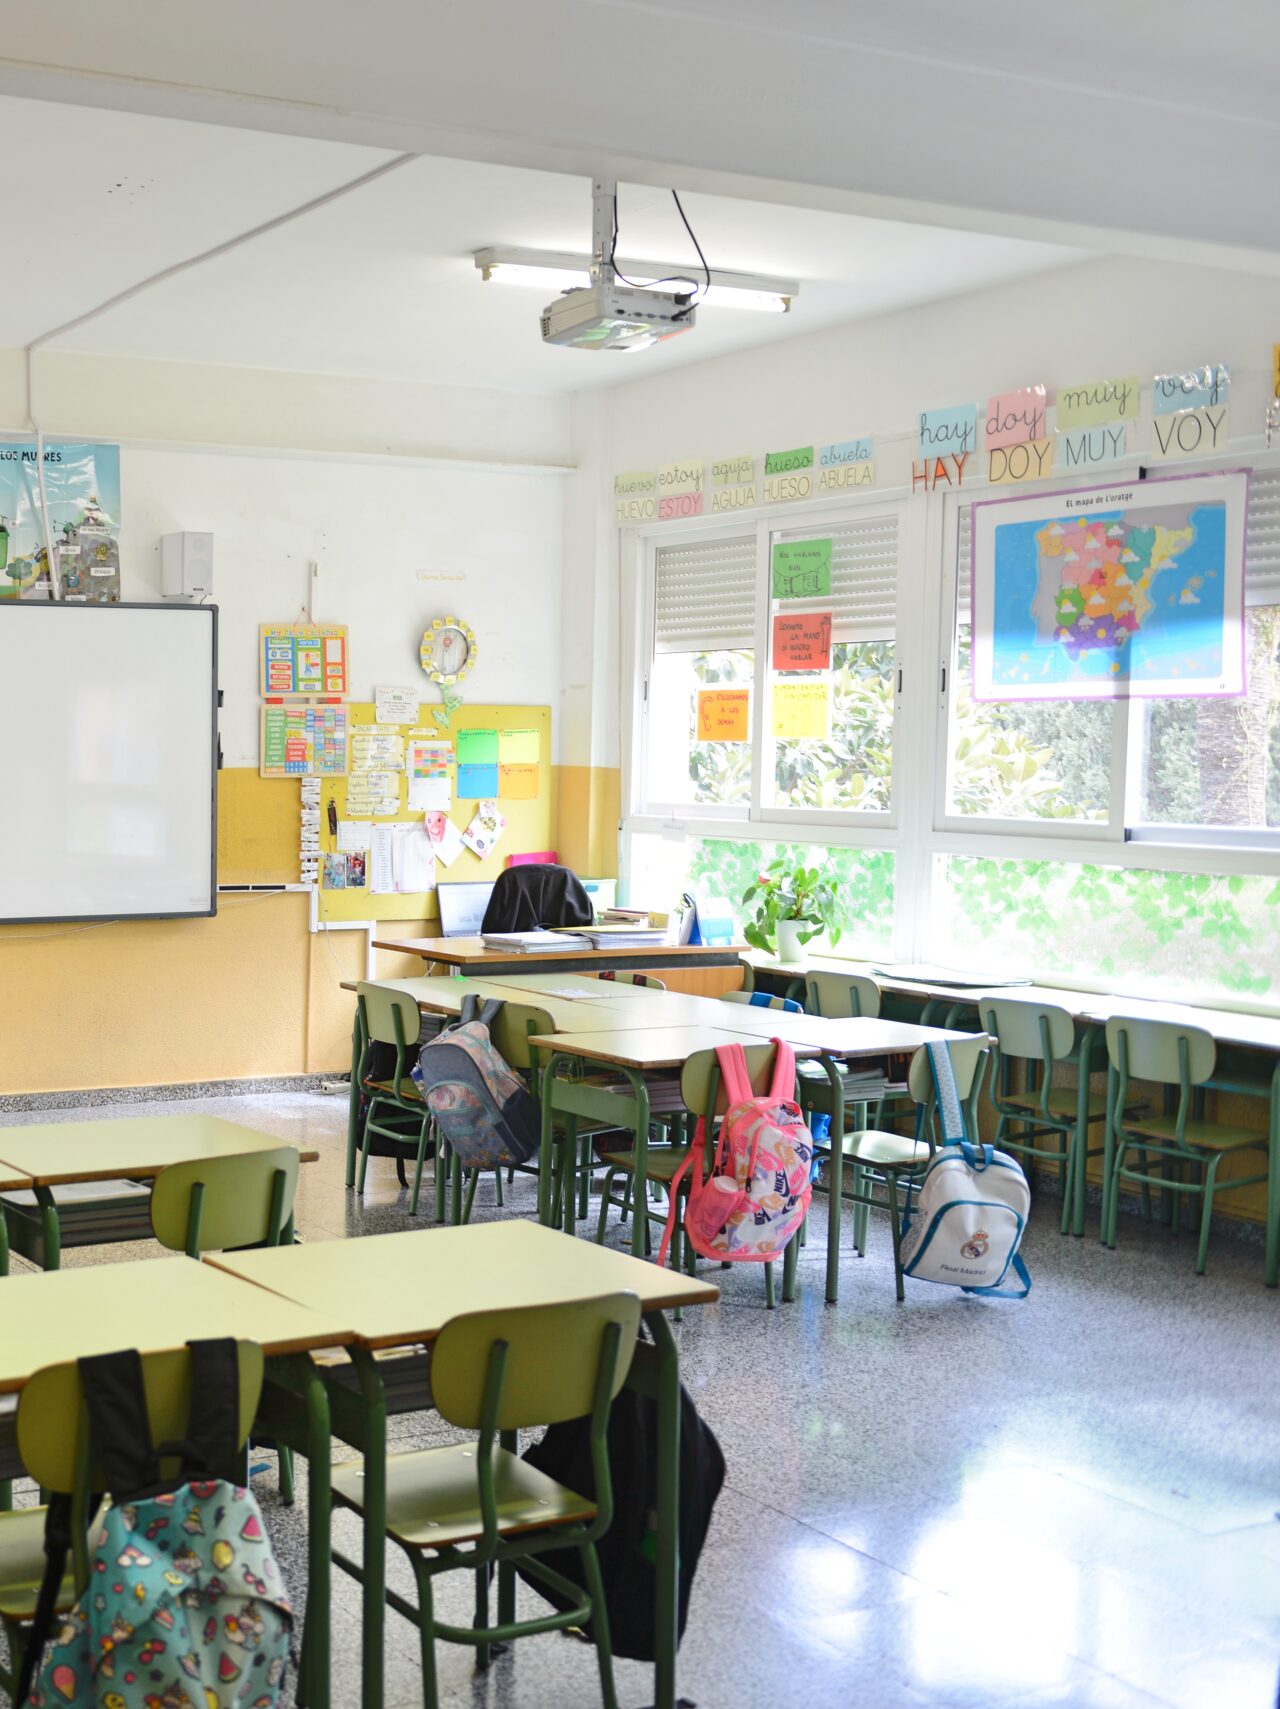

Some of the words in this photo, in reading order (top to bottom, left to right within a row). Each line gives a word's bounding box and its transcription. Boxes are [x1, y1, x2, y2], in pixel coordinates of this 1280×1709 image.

[1064, 383, 1132, 415] muy
[1156, 369, 1224, 407] voy
[986, 400, 1043, 441] doy
[1154, 409, 1226, 455] VOY
[920, 413, 973, 454] hay
[0, 451, 18, 461] LOS
[21, 451, 62, 462] MURES
[820, 441, 871, 465] abuela
[1066, 427, 1124, 466] MUY
[711, 459, 750, 484] aguja
[764, 453, 813, 475] hueso
[912, 451, 968, 494] HAY
[989, 441, 1051, 482] DOY
[614, 475, 655, 494] huevo
[659, 466, 702, 491] estoy
[763, 476, 810, 500] HUESO
[818, 465, 872, 490] ABUELA
[616, 499, 654, 520] HUEVO
[658, 494, 702, 519] ESTOY
[712, 487, 755, 513] AGUJA
[1066, 499, 1073, 508] El
[1075, 498, 1094, 507] mapa
[1095, 496, 1104, 504] de
[774, 1170, 785, 1194] NIKE
